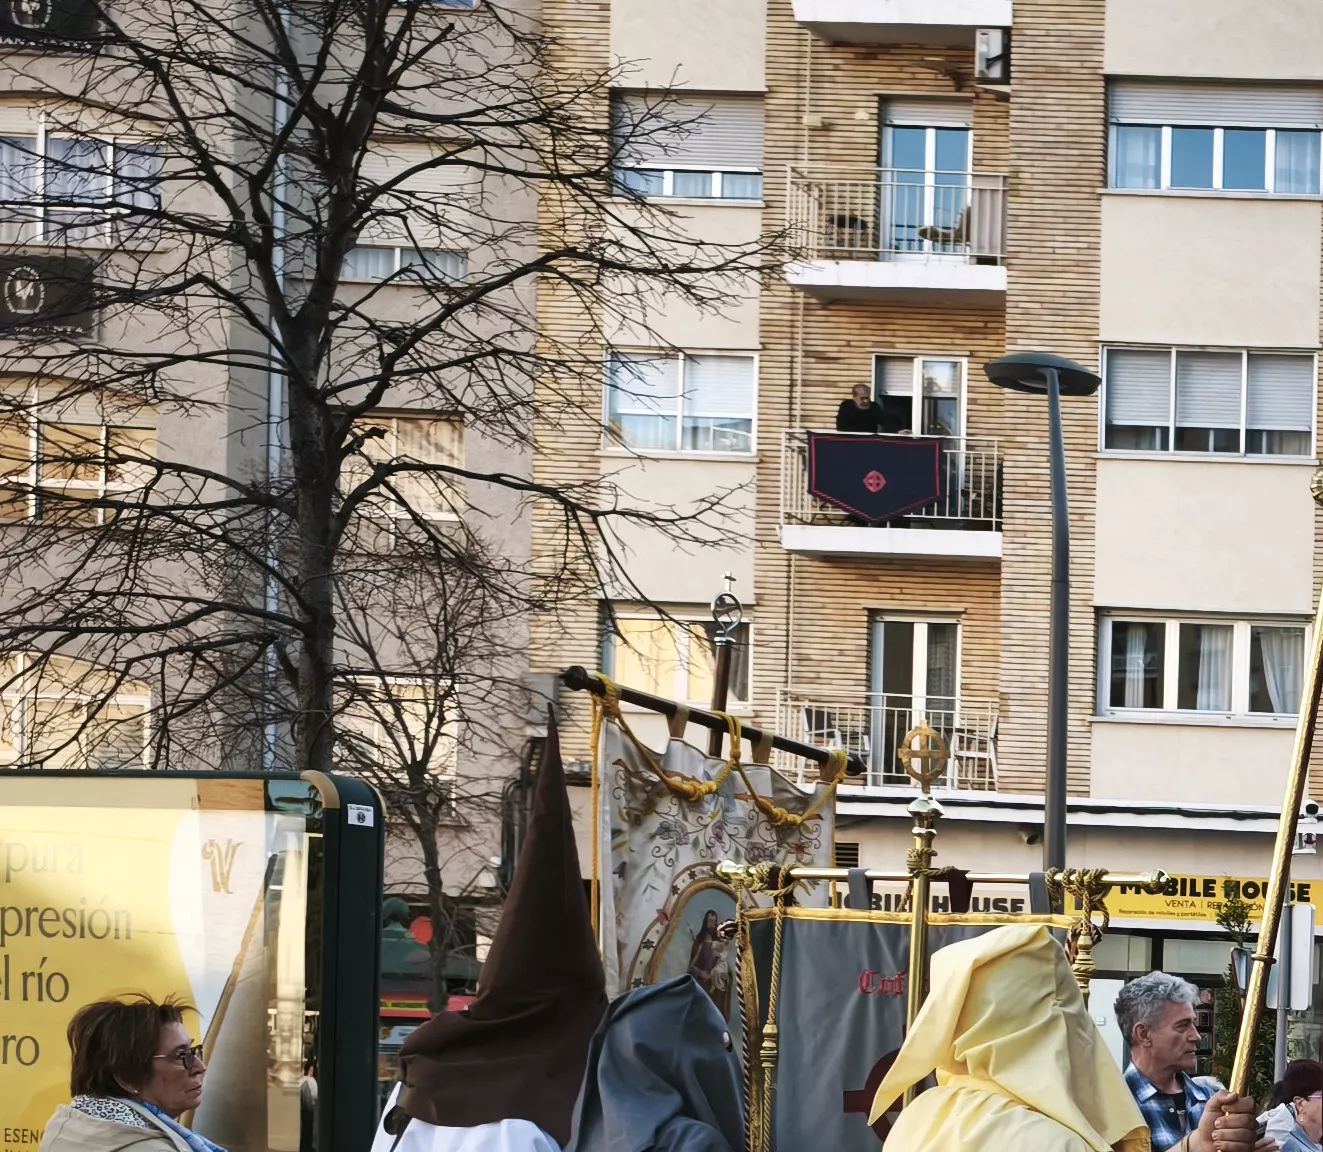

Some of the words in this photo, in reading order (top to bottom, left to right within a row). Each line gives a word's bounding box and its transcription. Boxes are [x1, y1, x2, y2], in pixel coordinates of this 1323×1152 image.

[932, 895, 1025, 913] HUSE
[1165, 900, 1197, 909] VENTA
[1223, 879, 1311, 903] HOE
[0, 894, 133, 948] presión
[0, 954, 10, 1001] l
[21, 956, 70, 1003] río
[2, 1033, 41, 1067] ro
